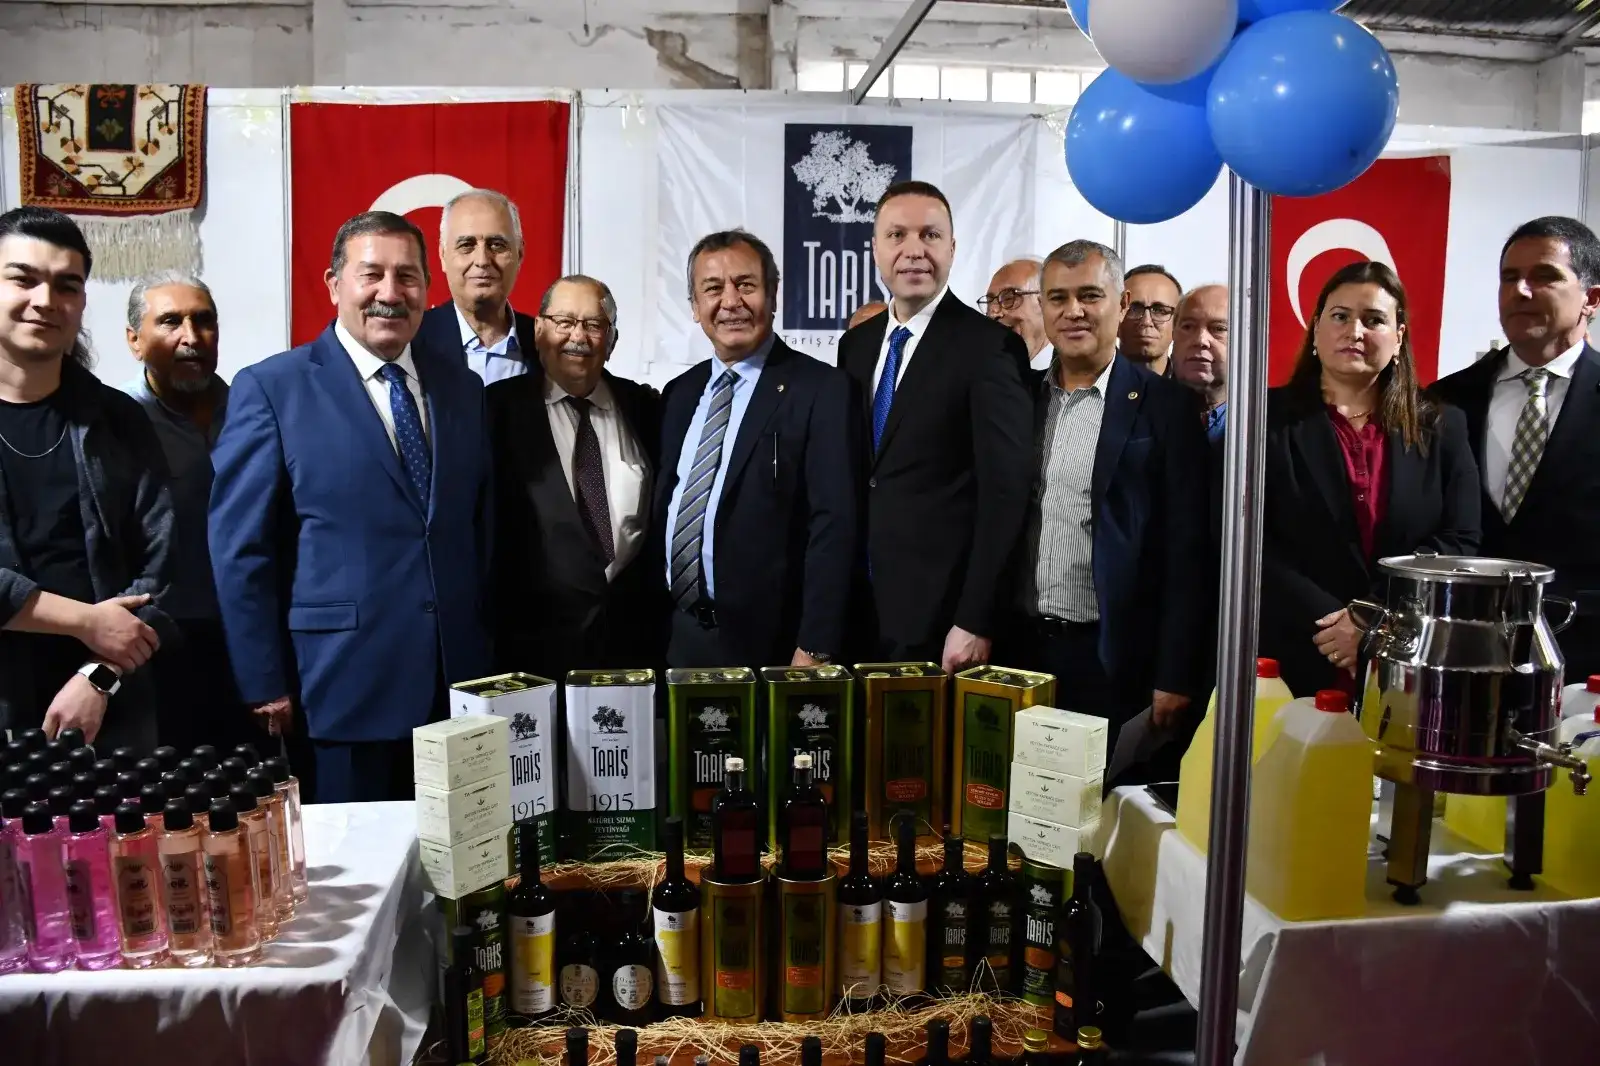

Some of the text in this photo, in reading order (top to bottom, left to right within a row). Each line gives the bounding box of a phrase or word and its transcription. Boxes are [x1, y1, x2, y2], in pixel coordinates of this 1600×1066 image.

[783, 335, 821, 348] Tariş
[509, 750, 542, 787] TARİŞ
[591, 745, 629, 780] TARİŞ
[793, 747, 831, 782] RİŞ
[511, 796, 546, 821] 1915
[590, 792, 634, 811] 1915
[587, 816, 636, 824] NATÜREL SIZMA
[594, 824, 630, 833] ZEYTİNYAĞI
[945, 926, 967, 946] TARİŞ
[1026, 914, 1054, 947] TARİŞ
